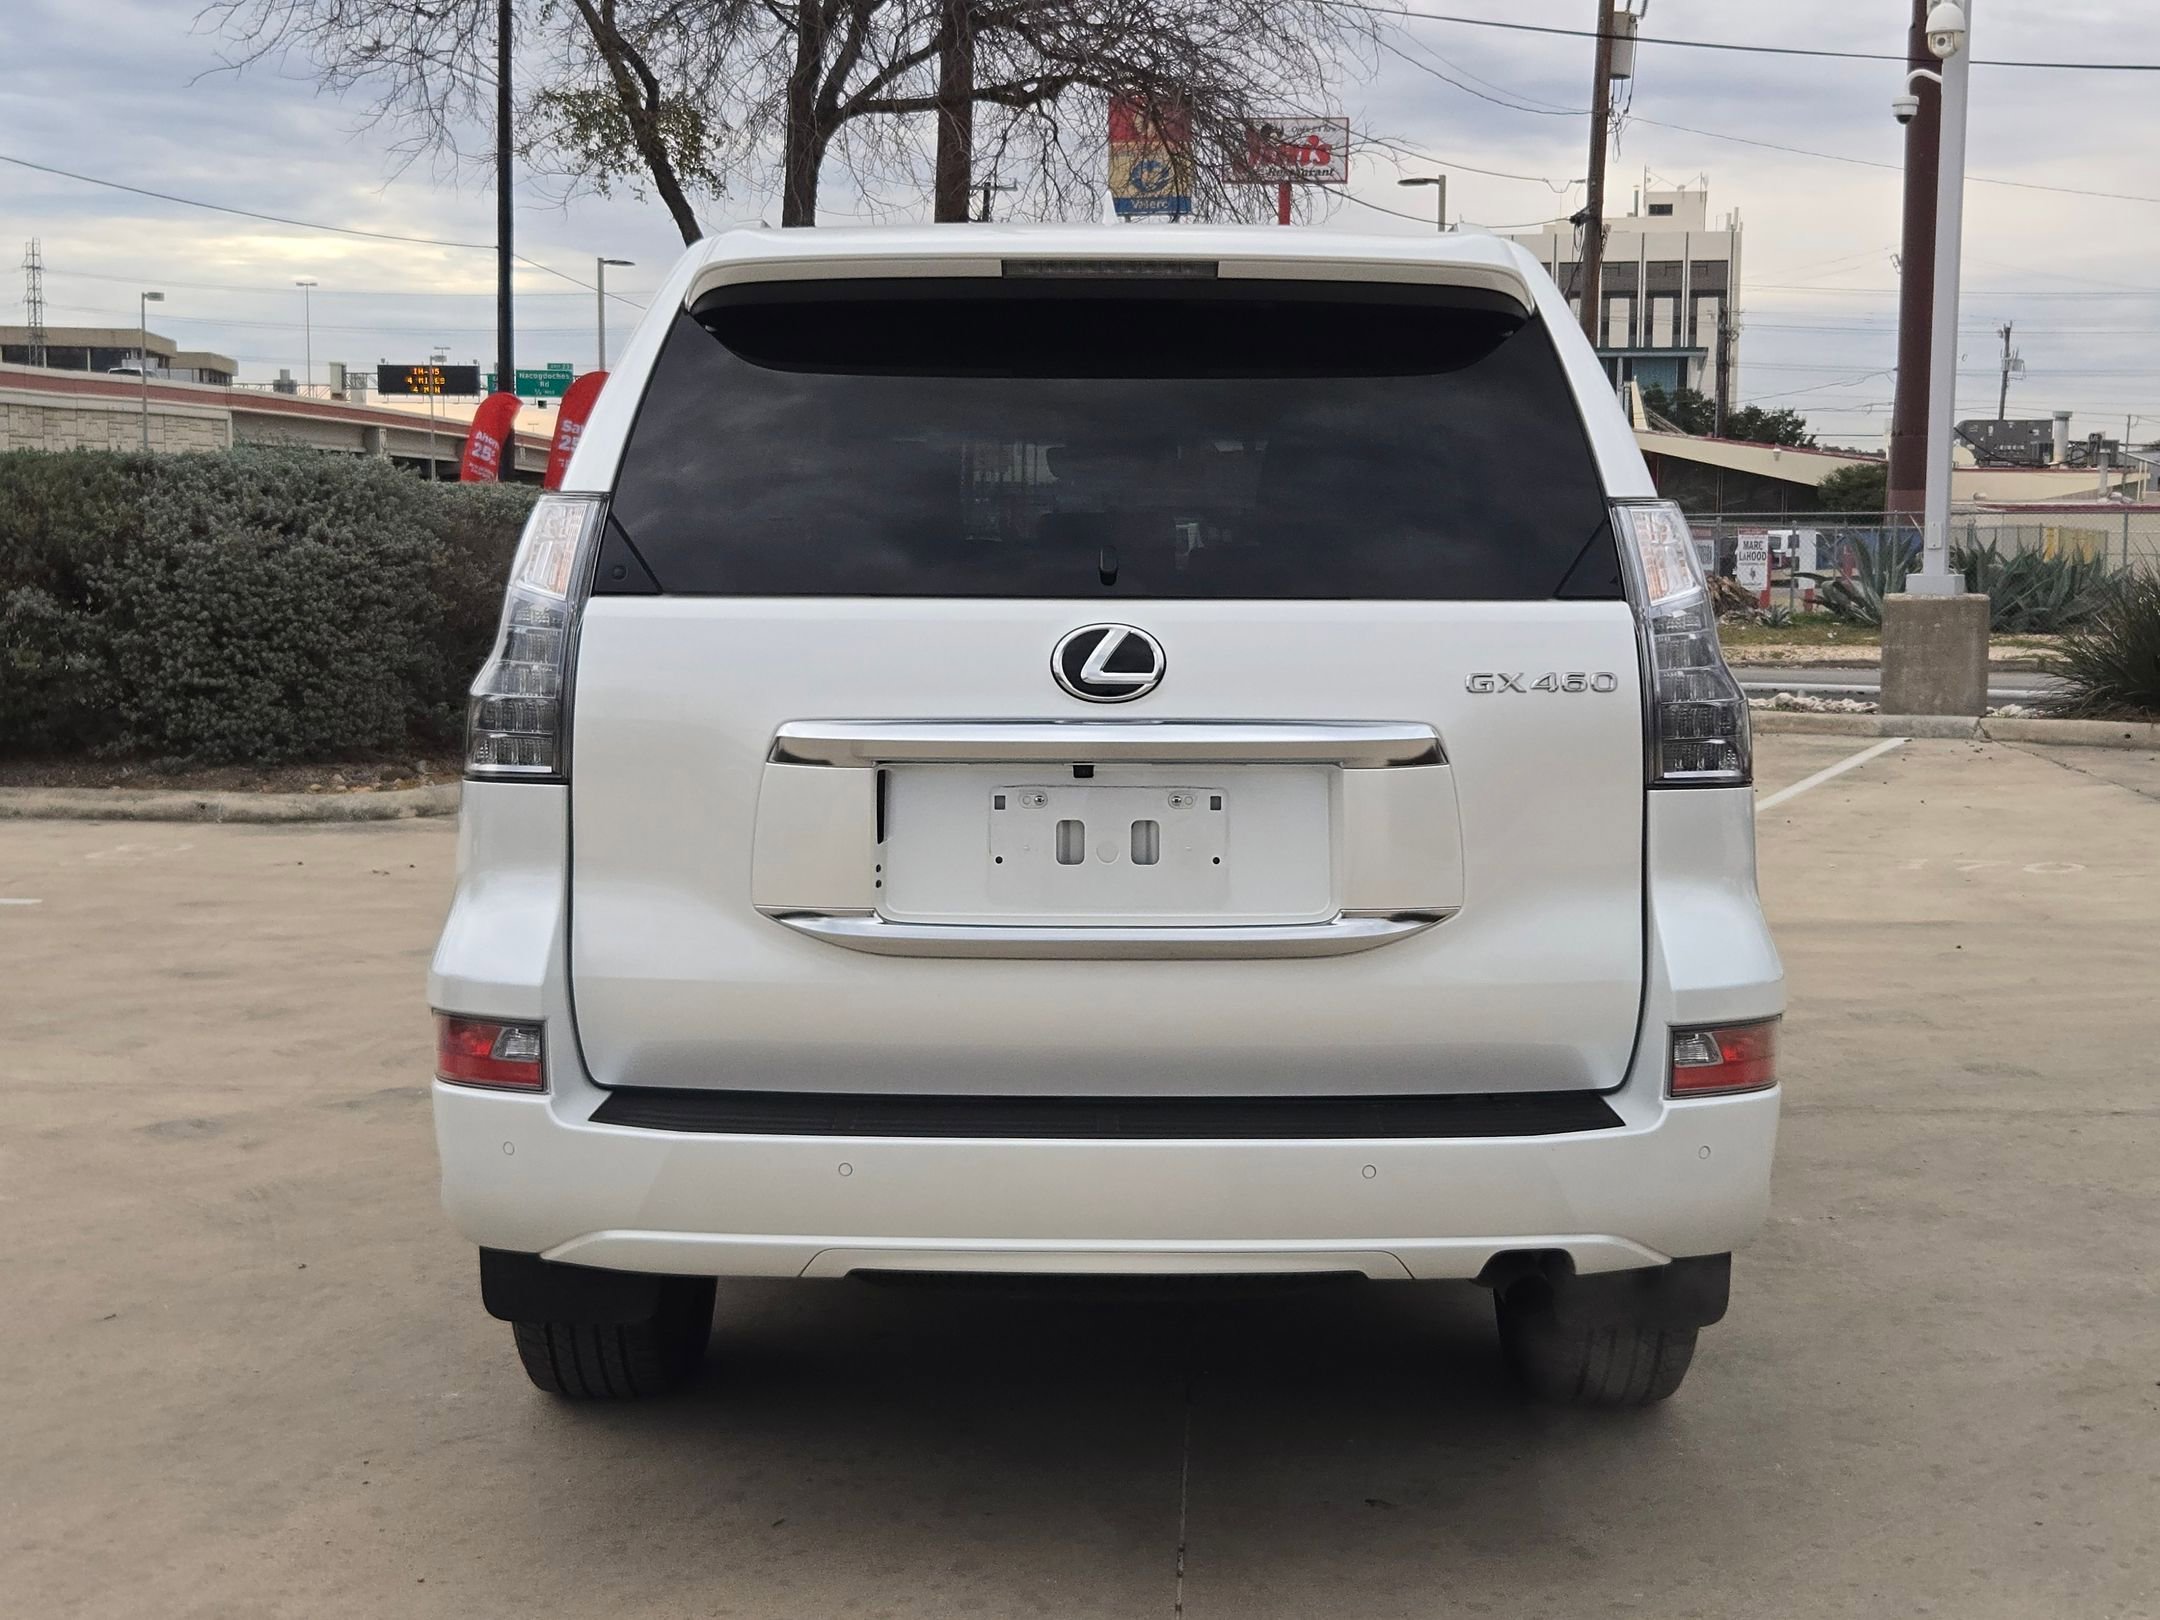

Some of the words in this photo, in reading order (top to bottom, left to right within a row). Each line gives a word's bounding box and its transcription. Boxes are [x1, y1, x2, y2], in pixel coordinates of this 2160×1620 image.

[519, 372, 570, 381] Nacogdoches
[418, 377, 446, 385] MIES
[424, 386, 441, 394] MN
[1743, 541, 1763, 550] MARC
